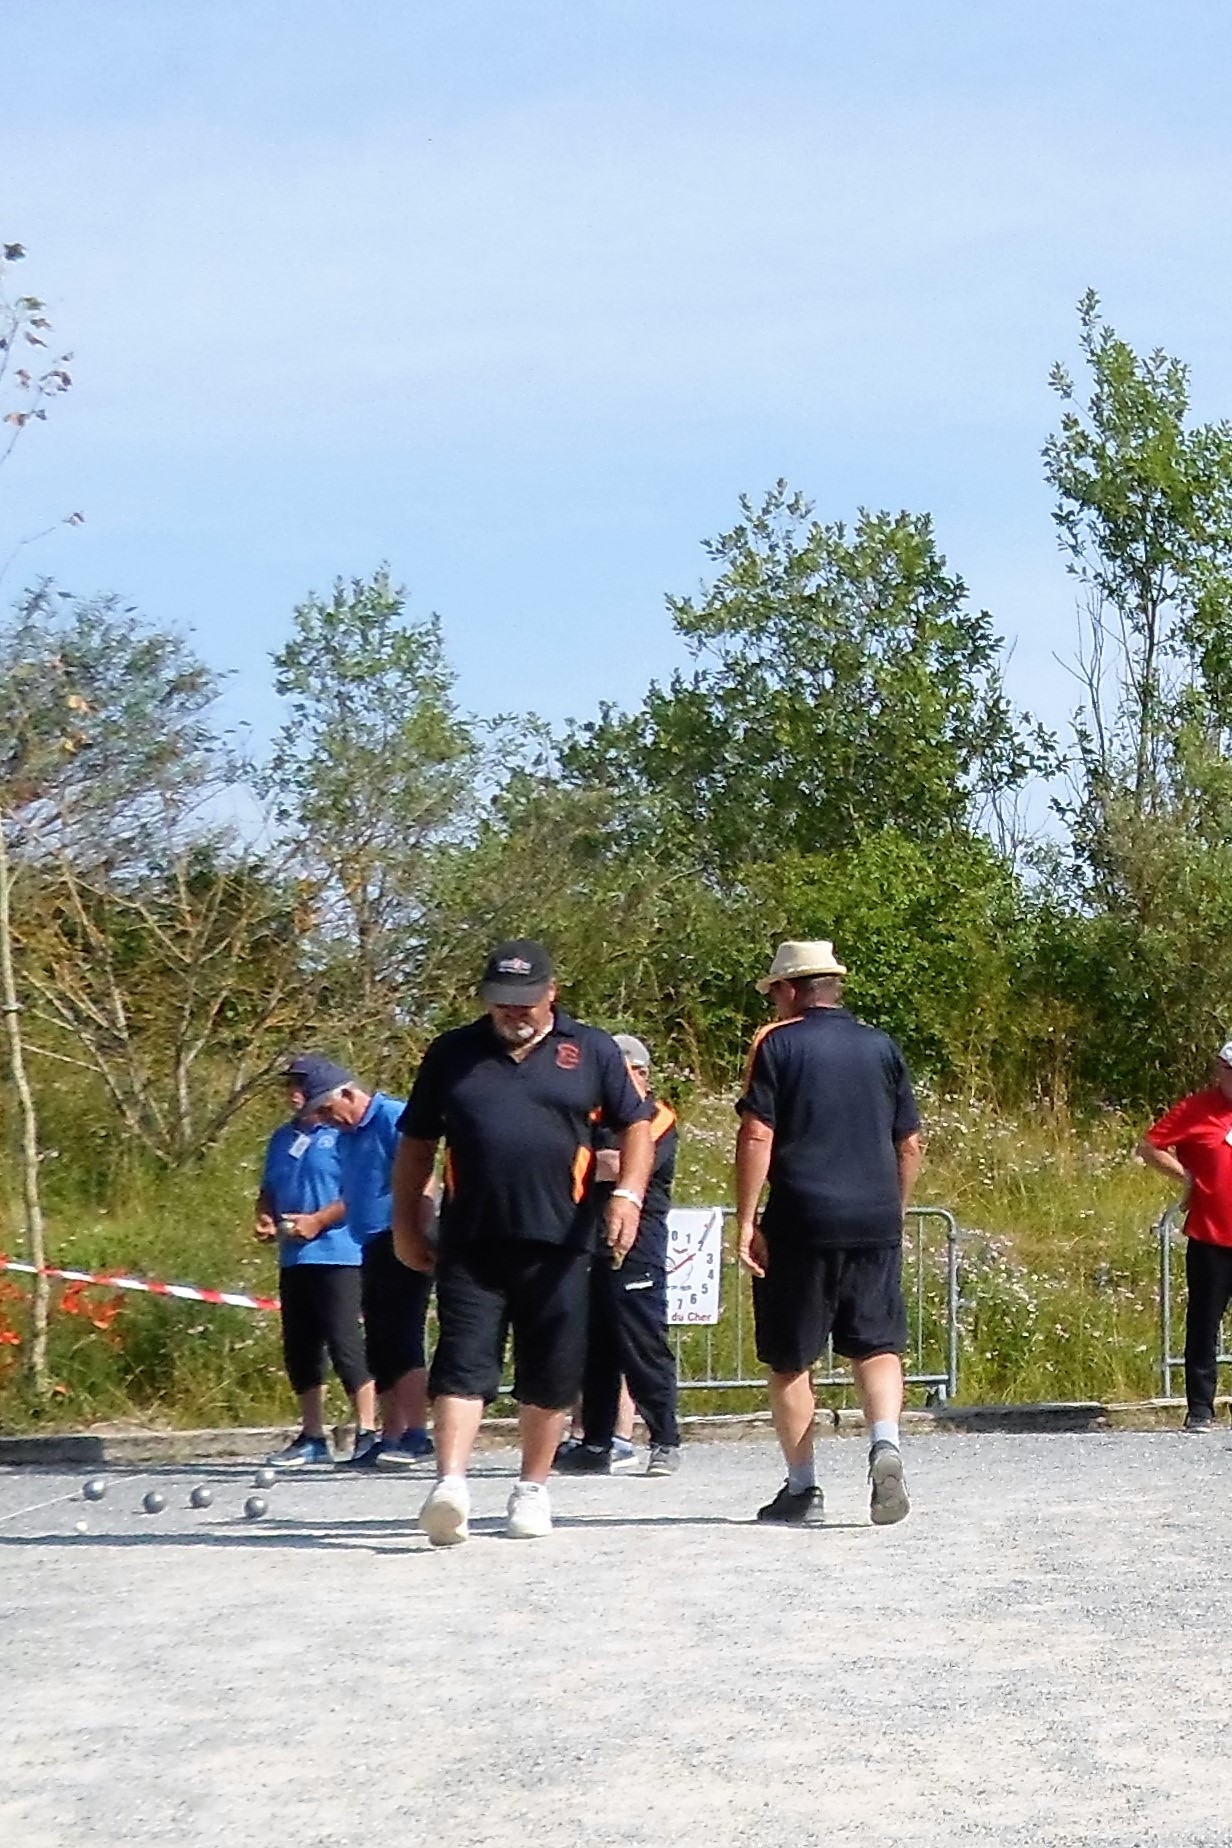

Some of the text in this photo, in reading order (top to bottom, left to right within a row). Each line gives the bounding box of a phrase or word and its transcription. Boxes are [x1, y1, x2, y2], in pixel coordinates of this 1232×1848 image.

[671, 1230, 679, 1241] 0
[685, 1233, 691, 1244] 1
[706, 1253, 714, 1264] 3
[707, 1269, 714, 1280] 4
[701, 1283, 708, 1294] 5
[677, 1298, 683, 1310] 7
[690, 1293, 697, 1304] 6
[671, 1312, 711, 1322] du Cher
